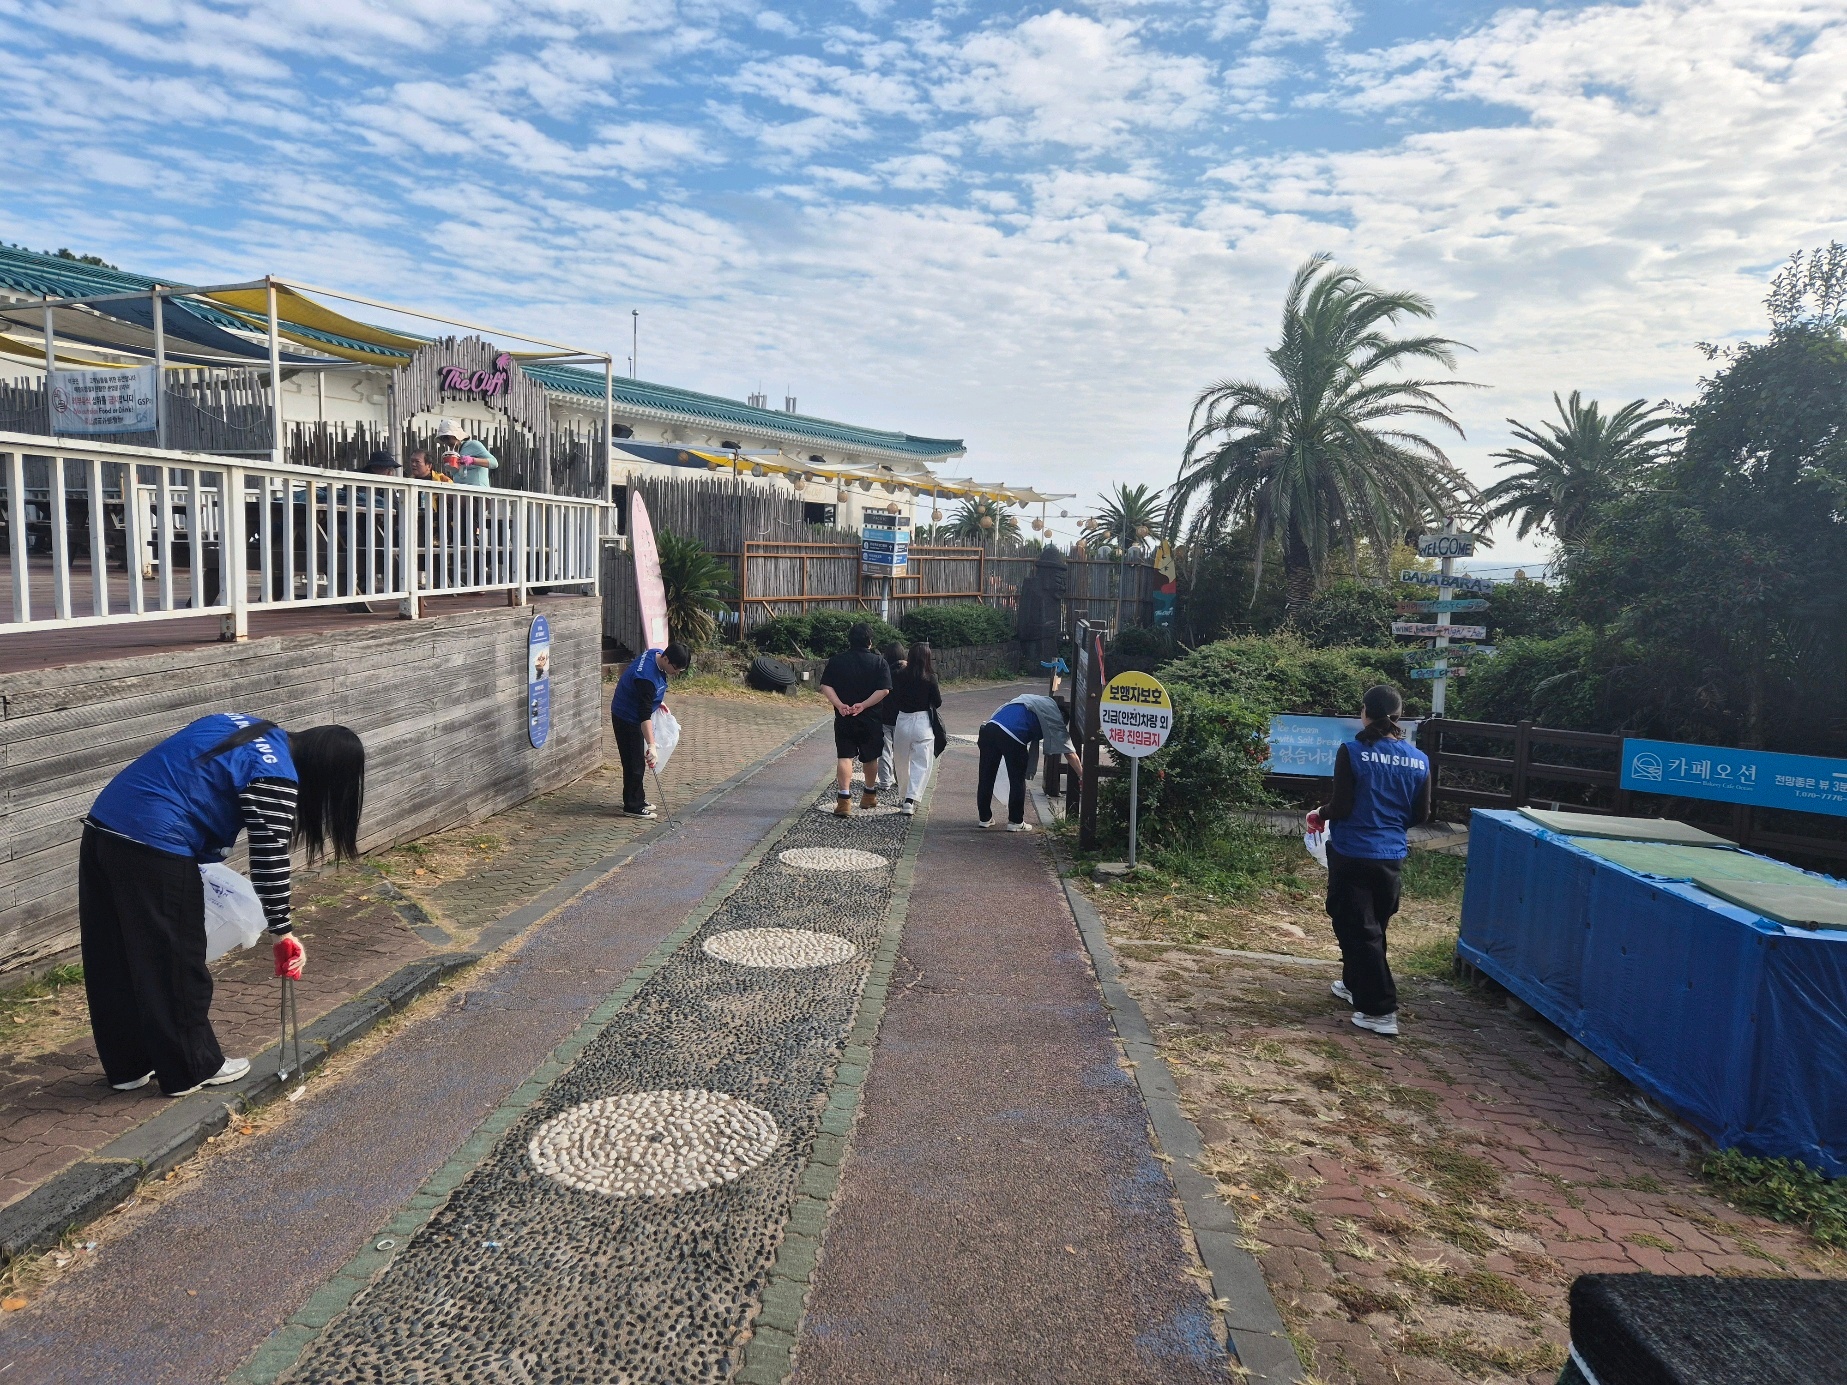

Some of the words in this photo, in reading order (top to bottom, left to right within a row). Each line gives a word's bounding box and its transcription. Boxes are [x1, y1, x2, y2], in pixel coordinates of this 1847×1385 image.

[442, 366, 470, 391] The
[471, 370, 506, 396] Cliff
[119, 406, 134, 414] Drink!
[1420, 537, 1472, 555] WELCOME
[1109, 685, 1162, 704] 보행자보호
[1103, 710, 1157, 729] 긴급(안전)차량
[1160, 716, 1168, 729] 외
[1277, 724, 1288, 732] Ice
[1292, 724, 1319, 734] Cream
[1109, 728, 1125, 742] 차량
[1127, 730, 1160, 747] 진입금지
[1297, 735, 1313, 745] Salt
[1317, 736, 1342, 746] Bread
[1279, 745, 1335, 766] 없습니다
[1361, 751, 1425, 770] SAMSUNG
[1668, 757, 1756, 784] 카페오션
[1775, 775, 1815, 789] 전망좋은
[1819, 780, 1829, 790] 뷰
